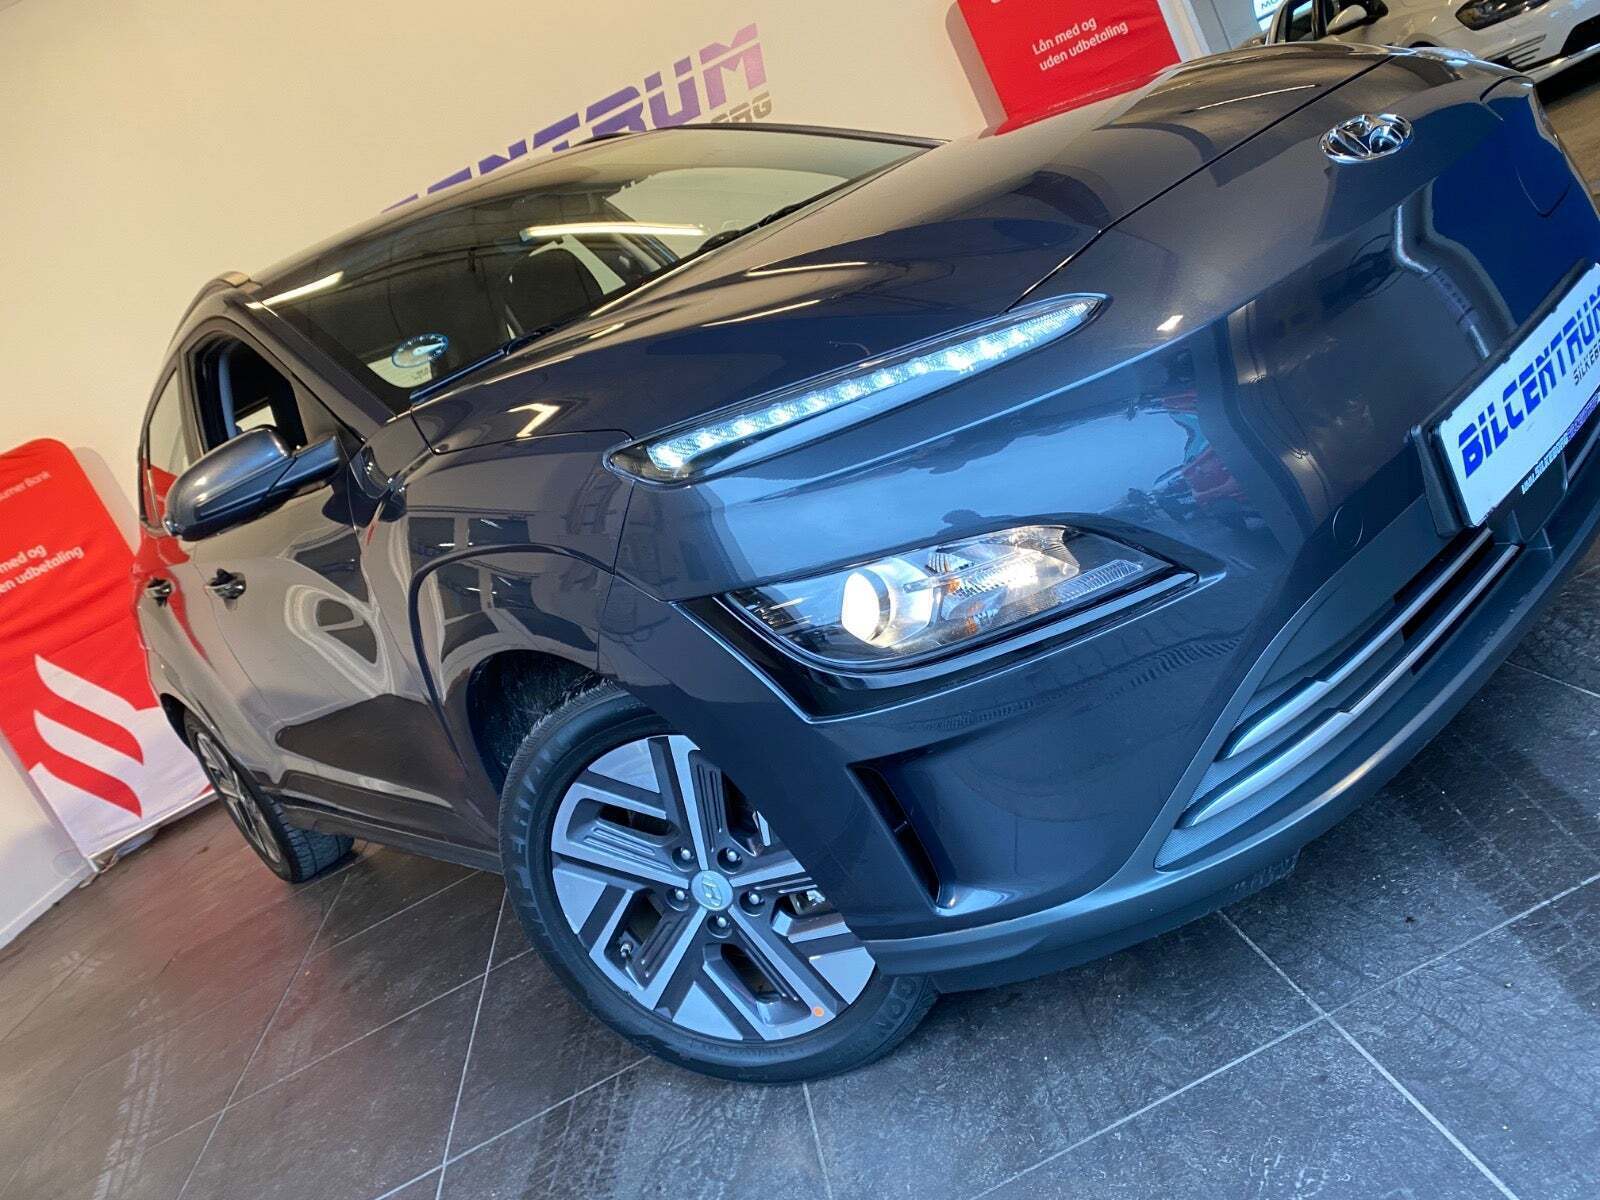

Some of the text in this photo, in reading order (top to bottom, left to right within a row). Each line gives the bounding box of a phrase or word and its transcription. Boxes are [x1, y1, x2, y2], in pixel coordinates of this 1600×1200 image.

[1032, 17, 1098, 56] Lån med og
[1039, 21, 1129, 71] uden udbetaling
[15, 546, 84, 585] udbetaling
[27, 545, 47, 559] og
